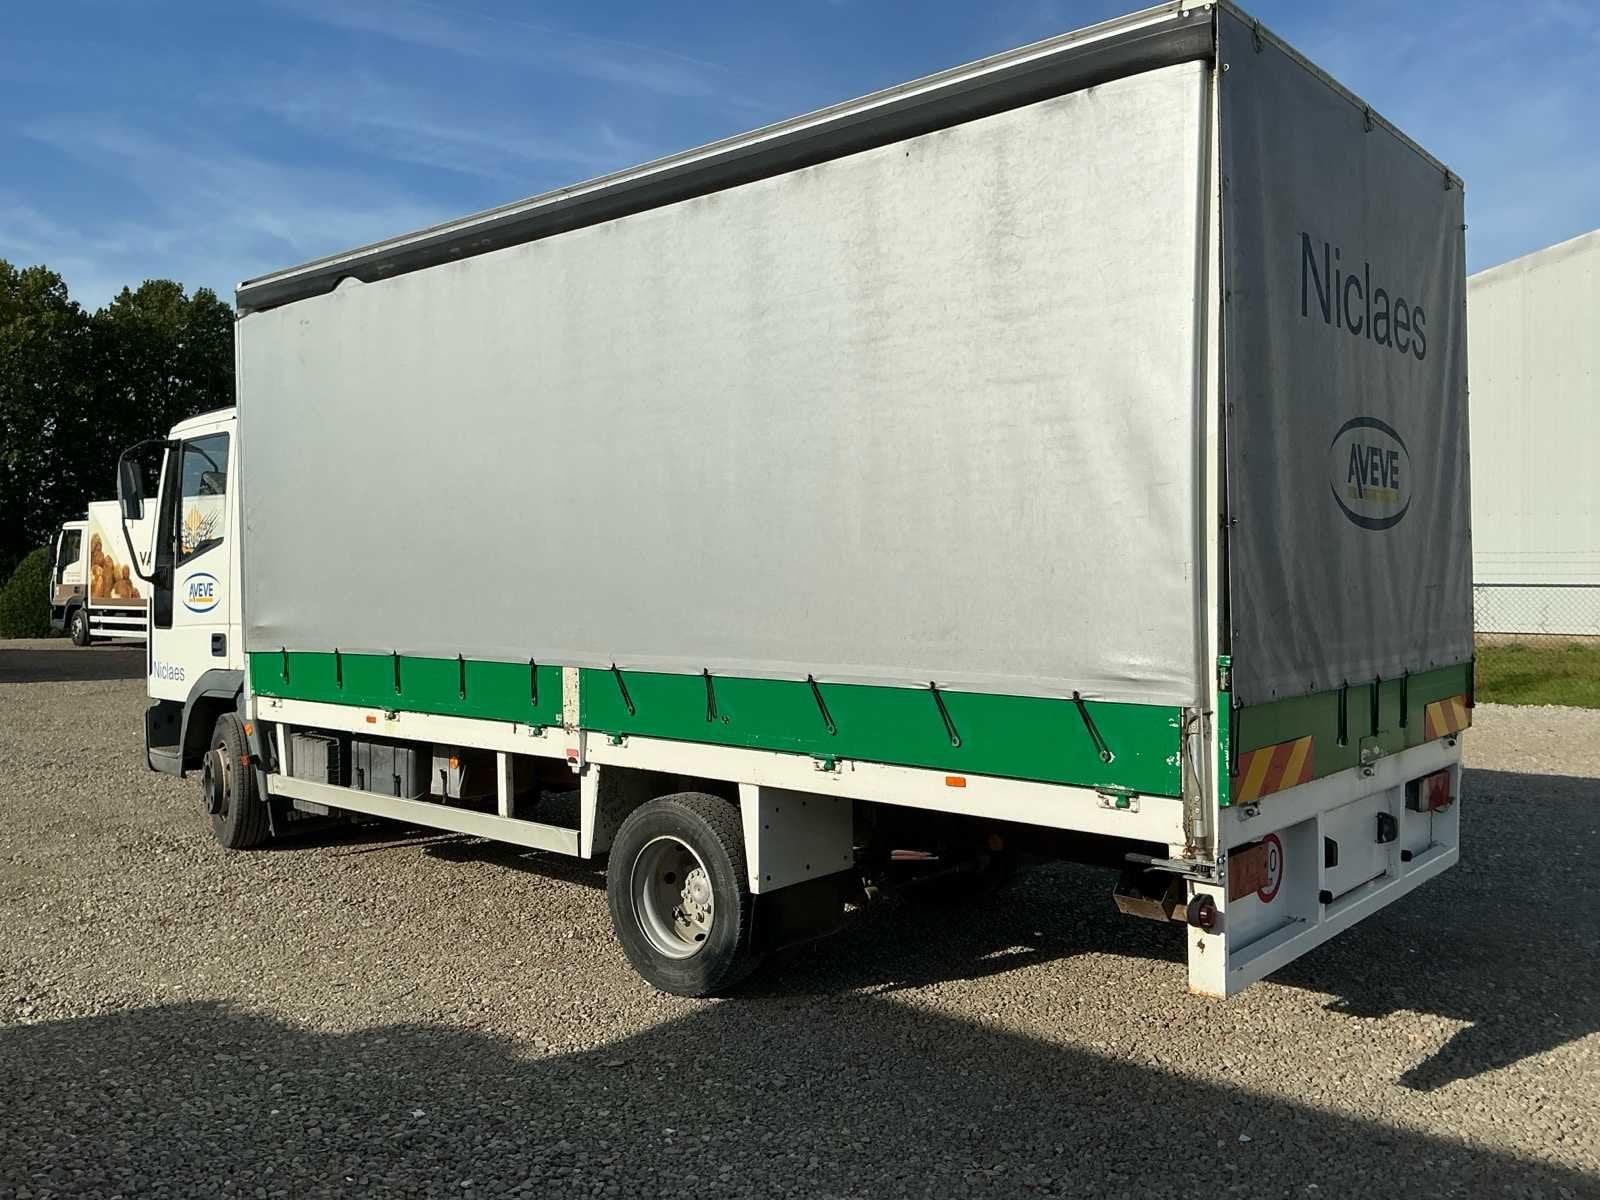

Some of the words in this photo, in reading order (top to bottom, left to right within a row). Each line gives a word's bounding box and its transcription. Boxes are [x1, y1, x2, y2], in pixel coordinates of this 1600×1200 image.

[1301, 231, 1427, 361] Niclaes
[1347, 443, 1399, 499] AVEVE
[189, 582, 213, 602] AVEVE
[153, 660, 185, 682] Niclaes
